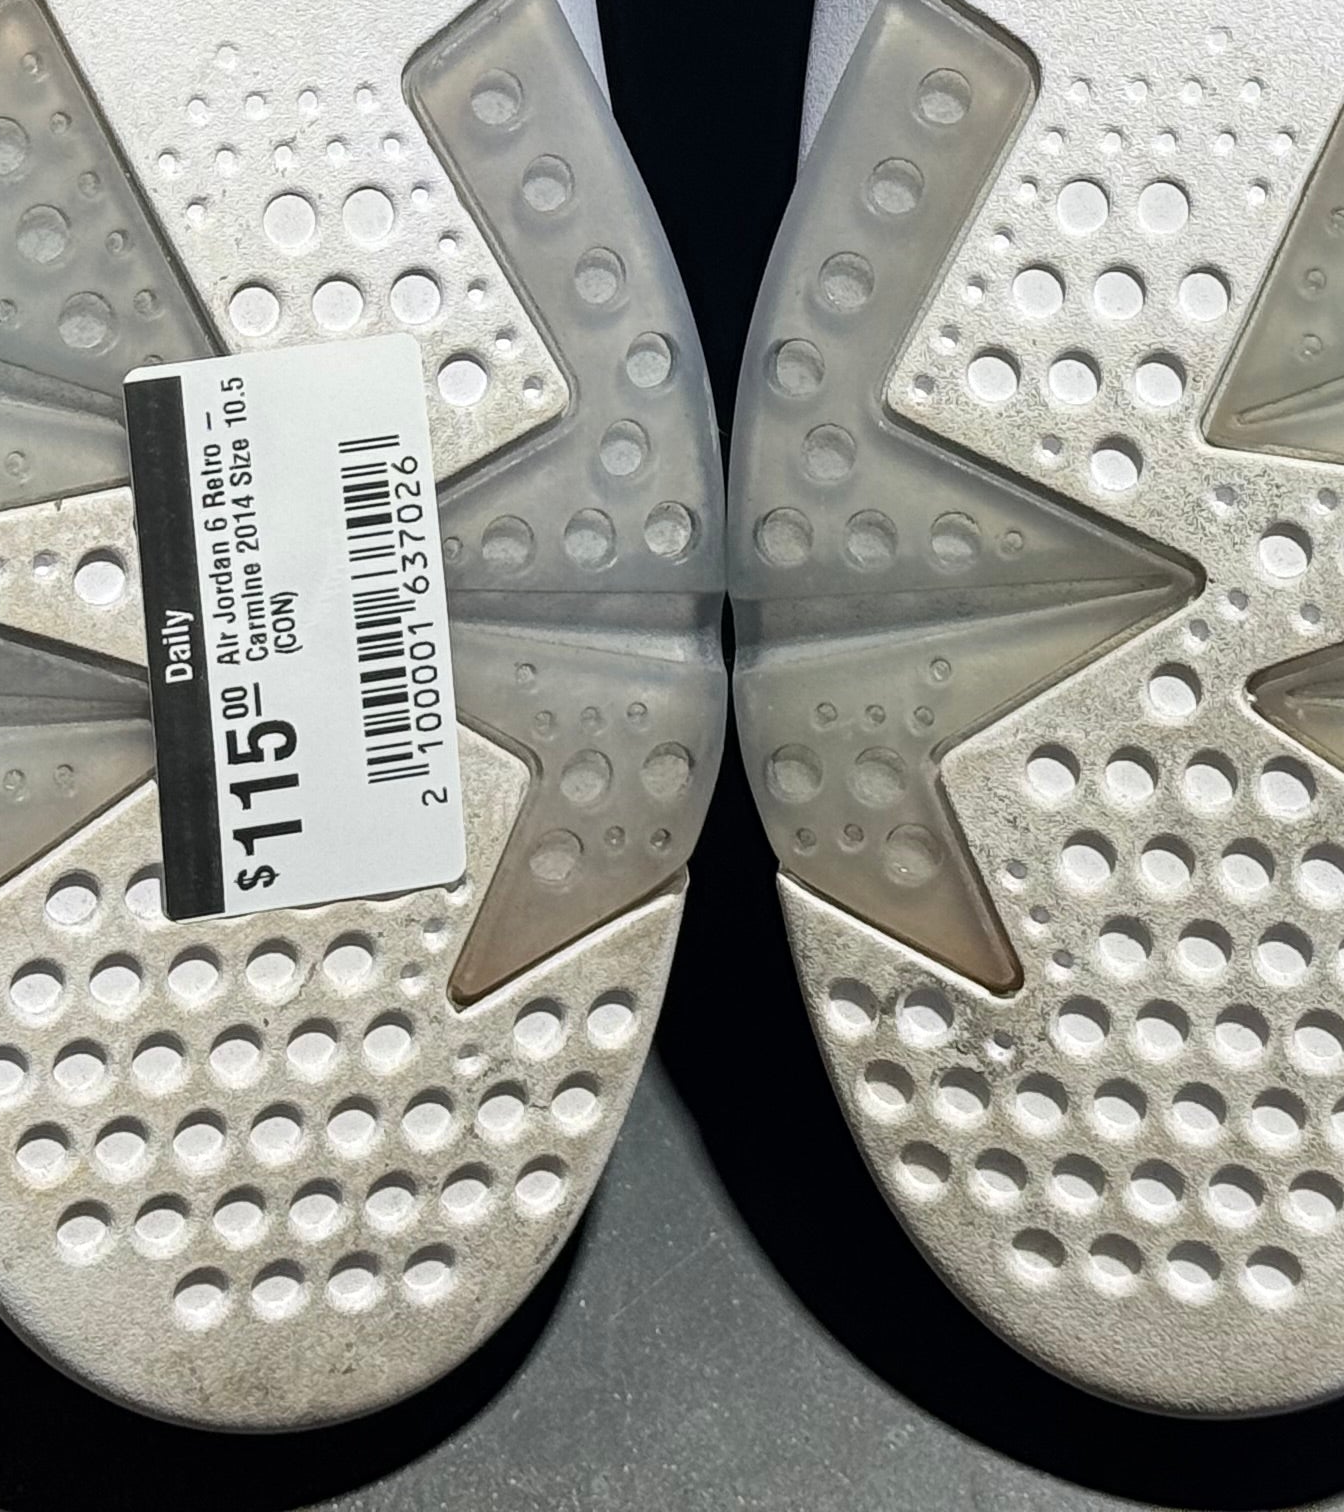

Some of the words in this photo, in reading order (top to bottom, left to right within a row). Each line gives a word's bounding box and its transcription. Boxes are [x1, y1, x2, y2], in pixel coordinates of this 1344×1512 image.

[220, 377, 249, 429] 10.5
[202, 443, 225, 511] Retro
[229, 437, 253, 487] Size
[205, 517, 228, 534] 6
[235, 496, 261, 554] 2014
[391, 455, 430, 595] 637026
[210, 539, 237, 624] Jordan
[241, 563, 269, 661] Carmine
[161, 609, 194, 684] Daily
[215, 634, 241, 665] Air
[269, 591, 303, 654] (CON)
[411, 621, 444, 754] 100001
[422, 785, 448, 806] 2
